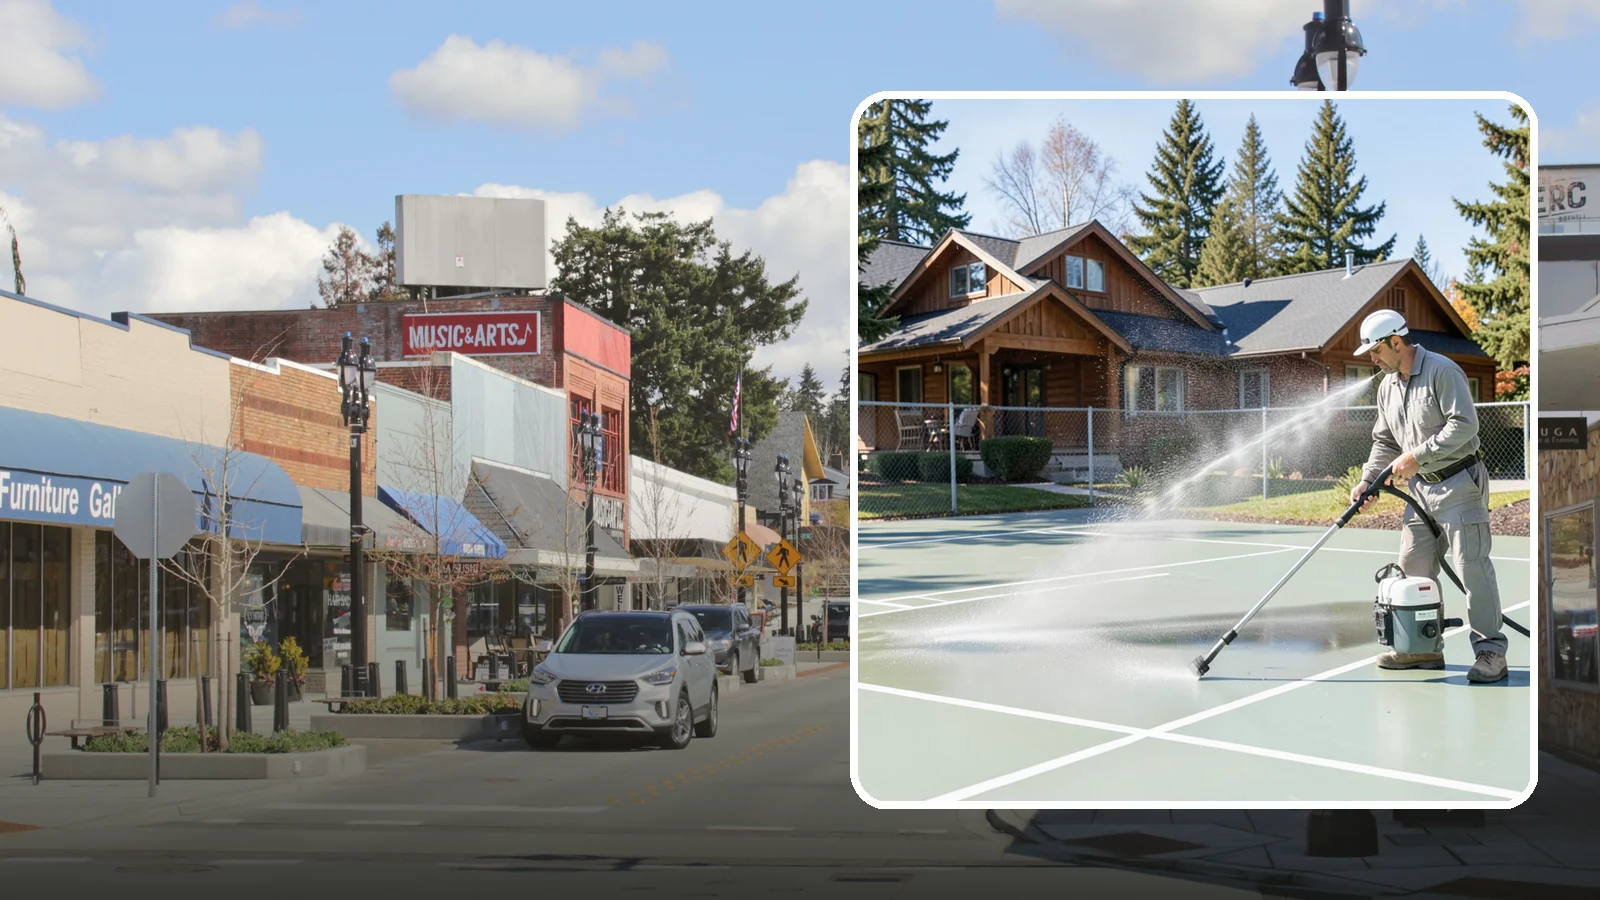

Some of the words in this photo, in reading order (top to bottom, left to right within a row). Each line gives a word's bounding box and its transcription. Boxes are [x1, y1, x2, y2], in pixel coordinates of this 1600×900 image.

[0, 472, 79, 515] Furniture
[89, 483, 121, 519] Gal
[453, 563, 479, 574] SUSHI
